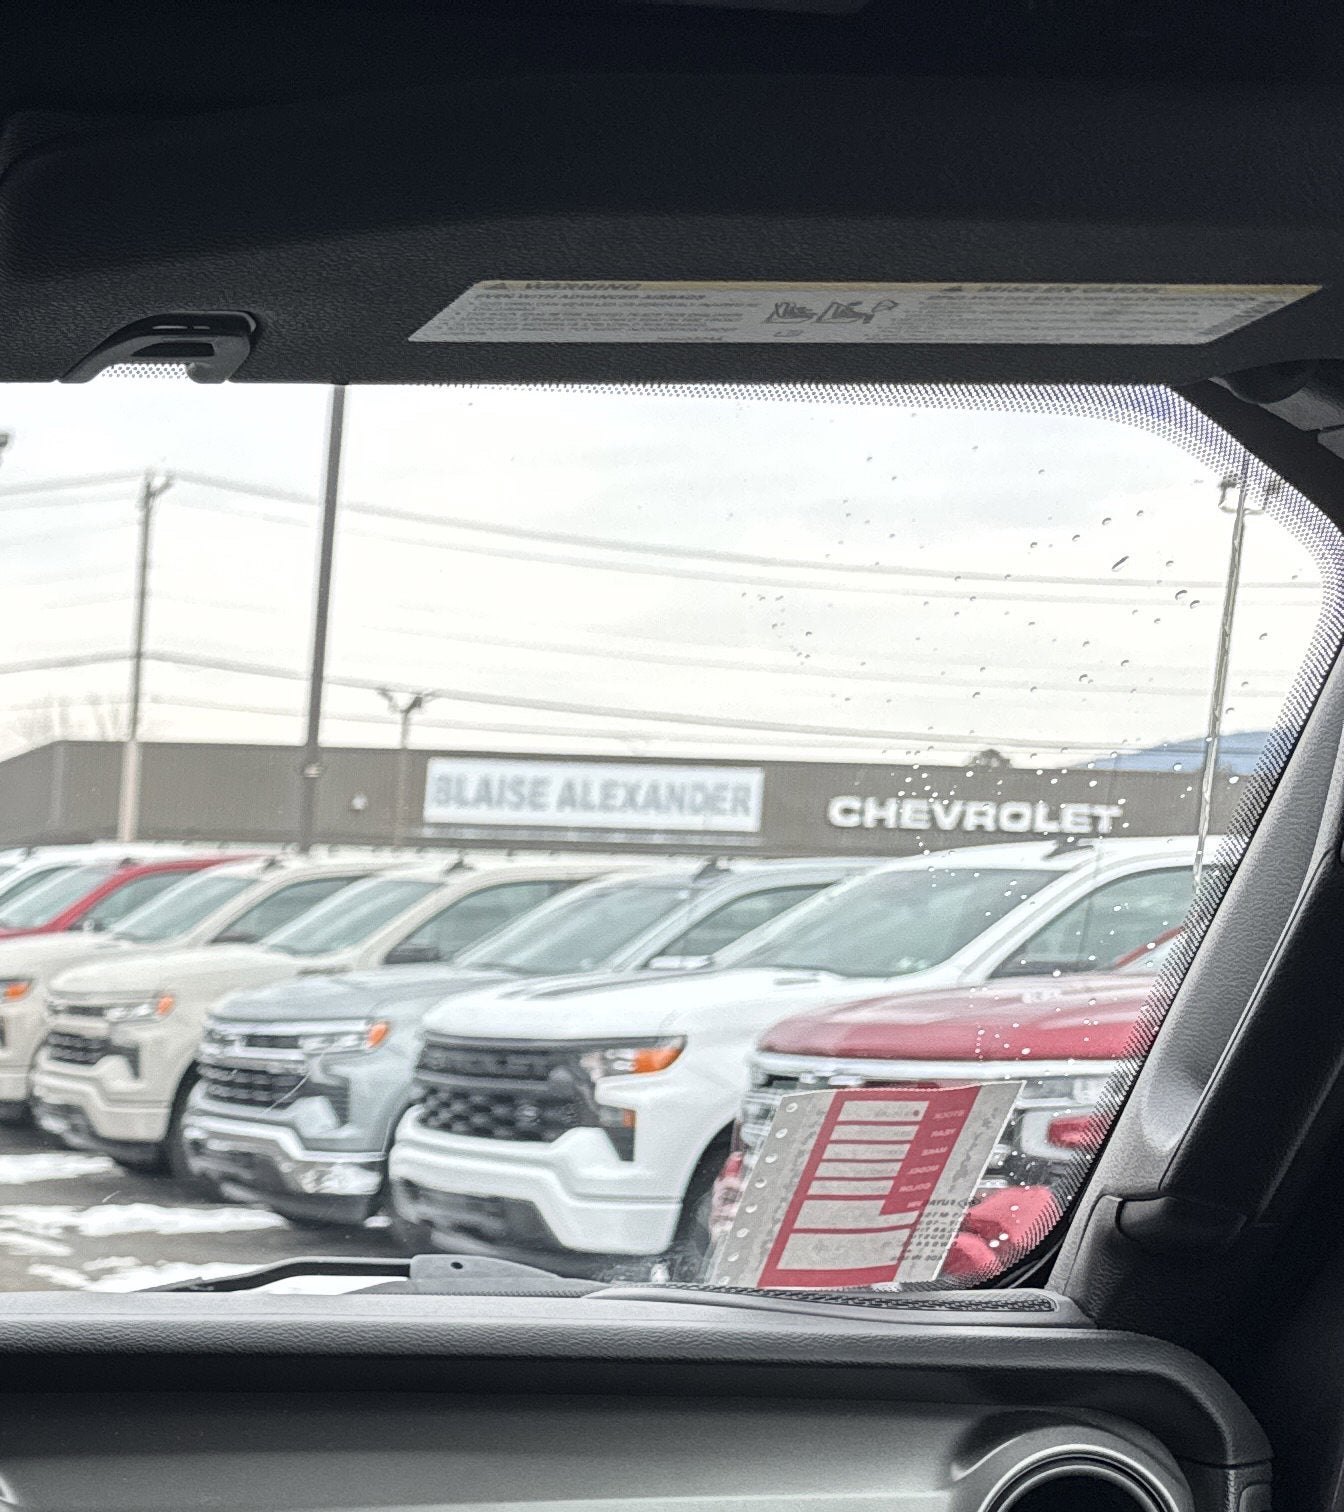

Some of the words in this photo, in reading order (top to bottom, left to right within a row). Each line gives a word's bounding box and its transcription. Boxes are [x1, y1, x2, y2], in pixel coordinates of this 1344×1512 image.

[434, 773, 551, 811] BLAISE
[556, 777, 752, 818] ALEXANDER
[827, 795, 1123, 834] CHEVROLET
